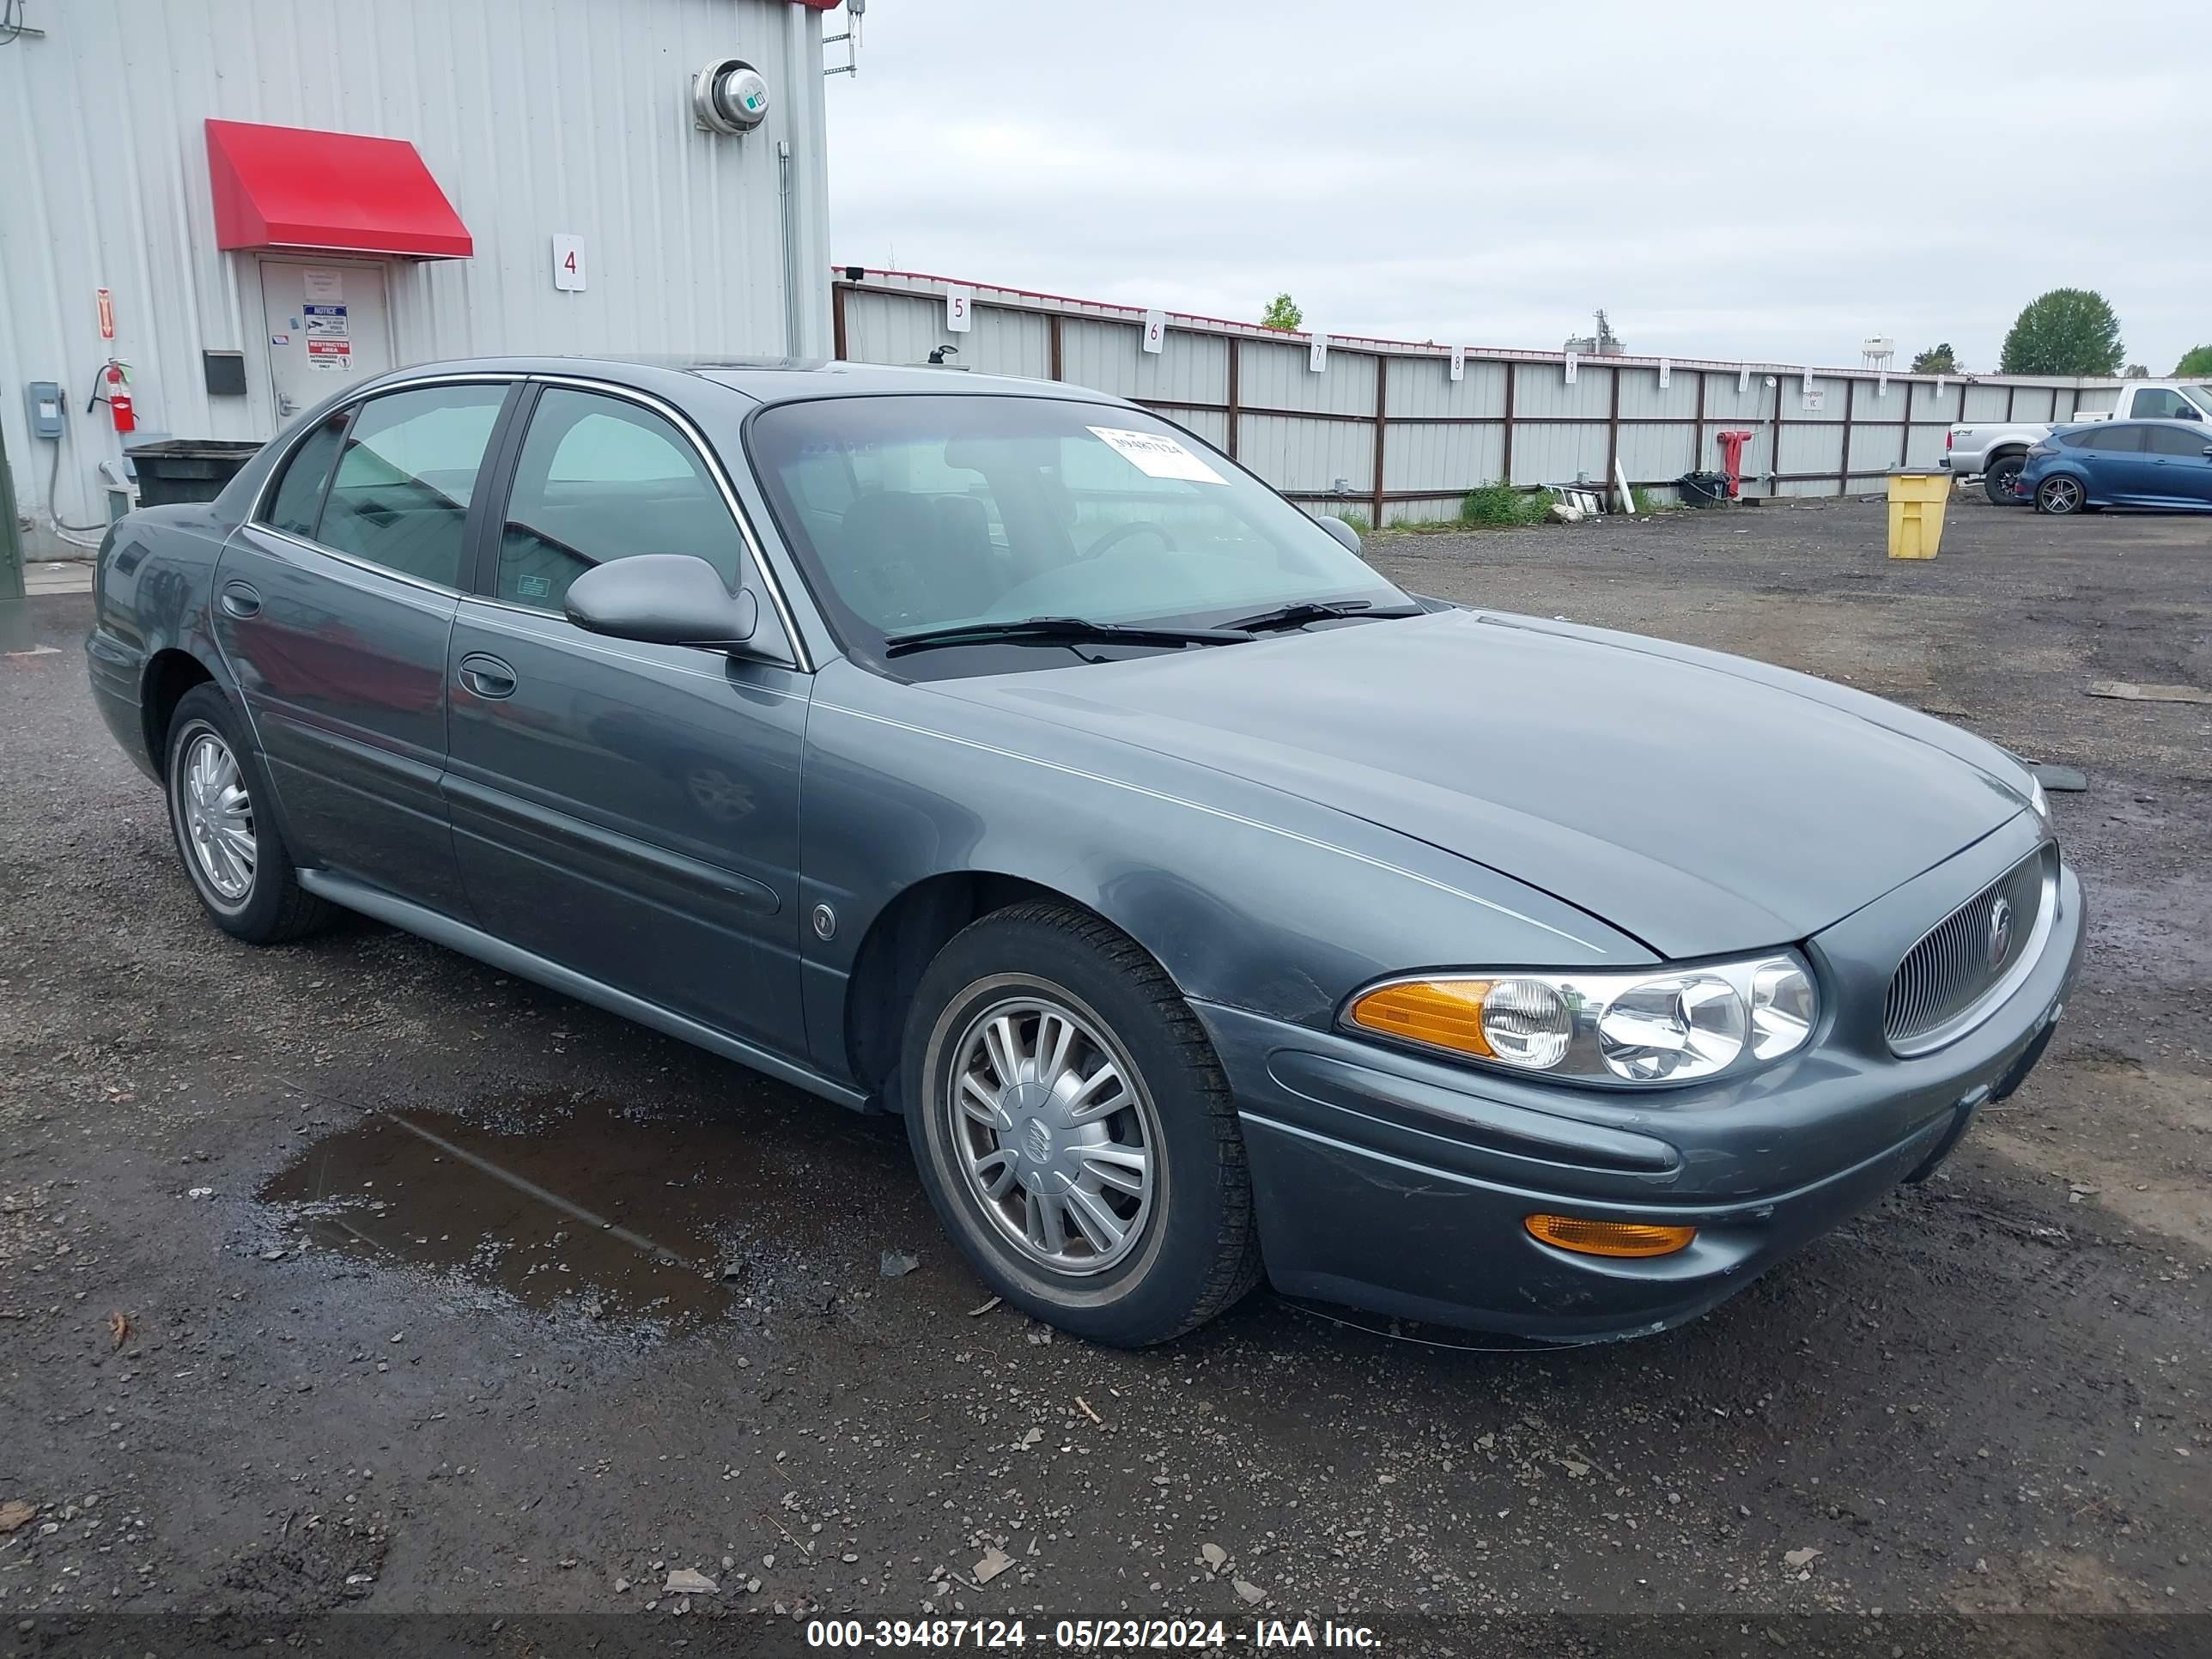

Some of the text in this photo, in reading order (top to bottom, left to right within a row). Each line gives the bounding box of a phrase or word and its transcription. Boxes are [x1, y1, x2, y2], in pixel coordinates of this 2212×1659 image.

[564, 251, 576, 275] 4
[955, 298, 963, 318] 5
[1150, 324, 1158, 340] 6
[1315, 344, 1322, 362] 7
[1455, 356, 1461, 371] 8
[1569, 362, 1574, 374] 9
[1662, 367, 1668, 380] 10
[1741, 372, 1748, 386] 11
[1805, 374, 1811, 386] 12
[1111, 438, 1184, 455] 39487124
